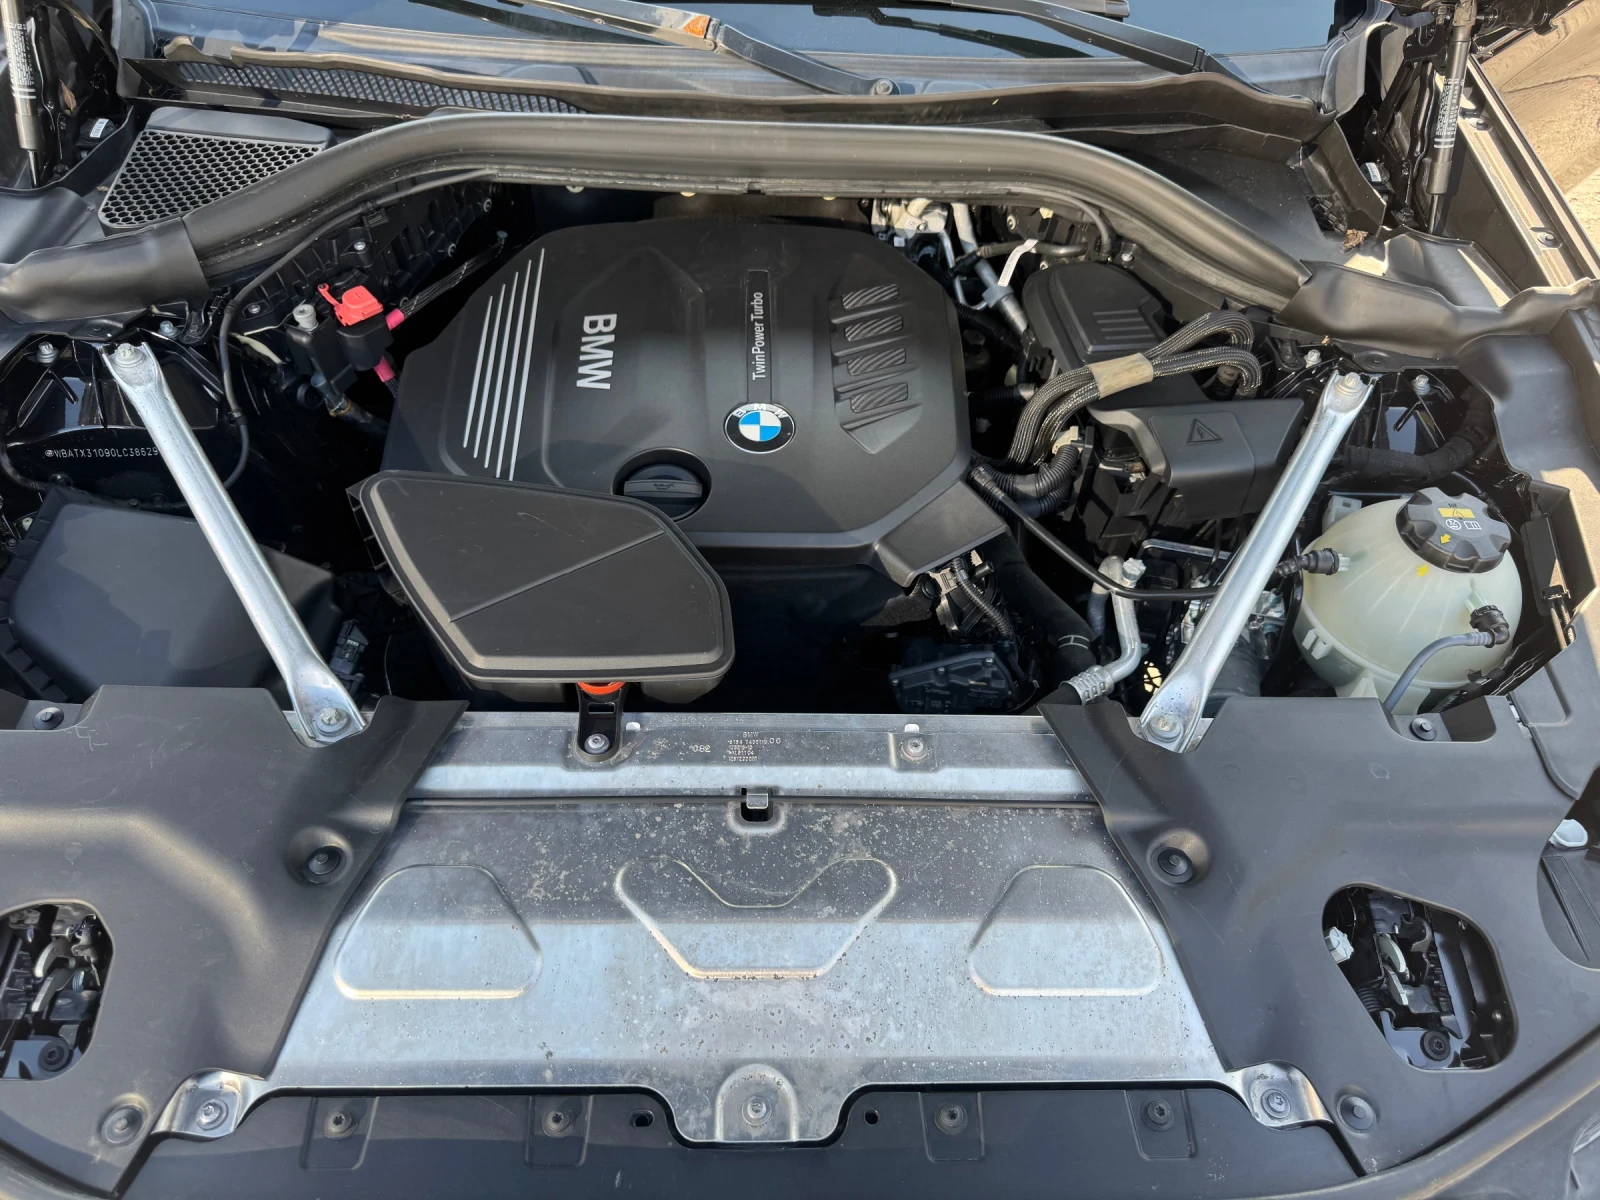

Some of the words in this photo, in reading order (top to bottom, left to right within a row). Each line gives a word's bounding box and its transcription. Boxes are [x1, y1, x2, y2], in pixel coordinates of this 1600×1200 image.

[750, 291, 764, 321] Turbo
[576, 313, 617, 389] BMW
[751, 321, 766, 381] TwinPower
[732, 403, 789, 418] BMW
